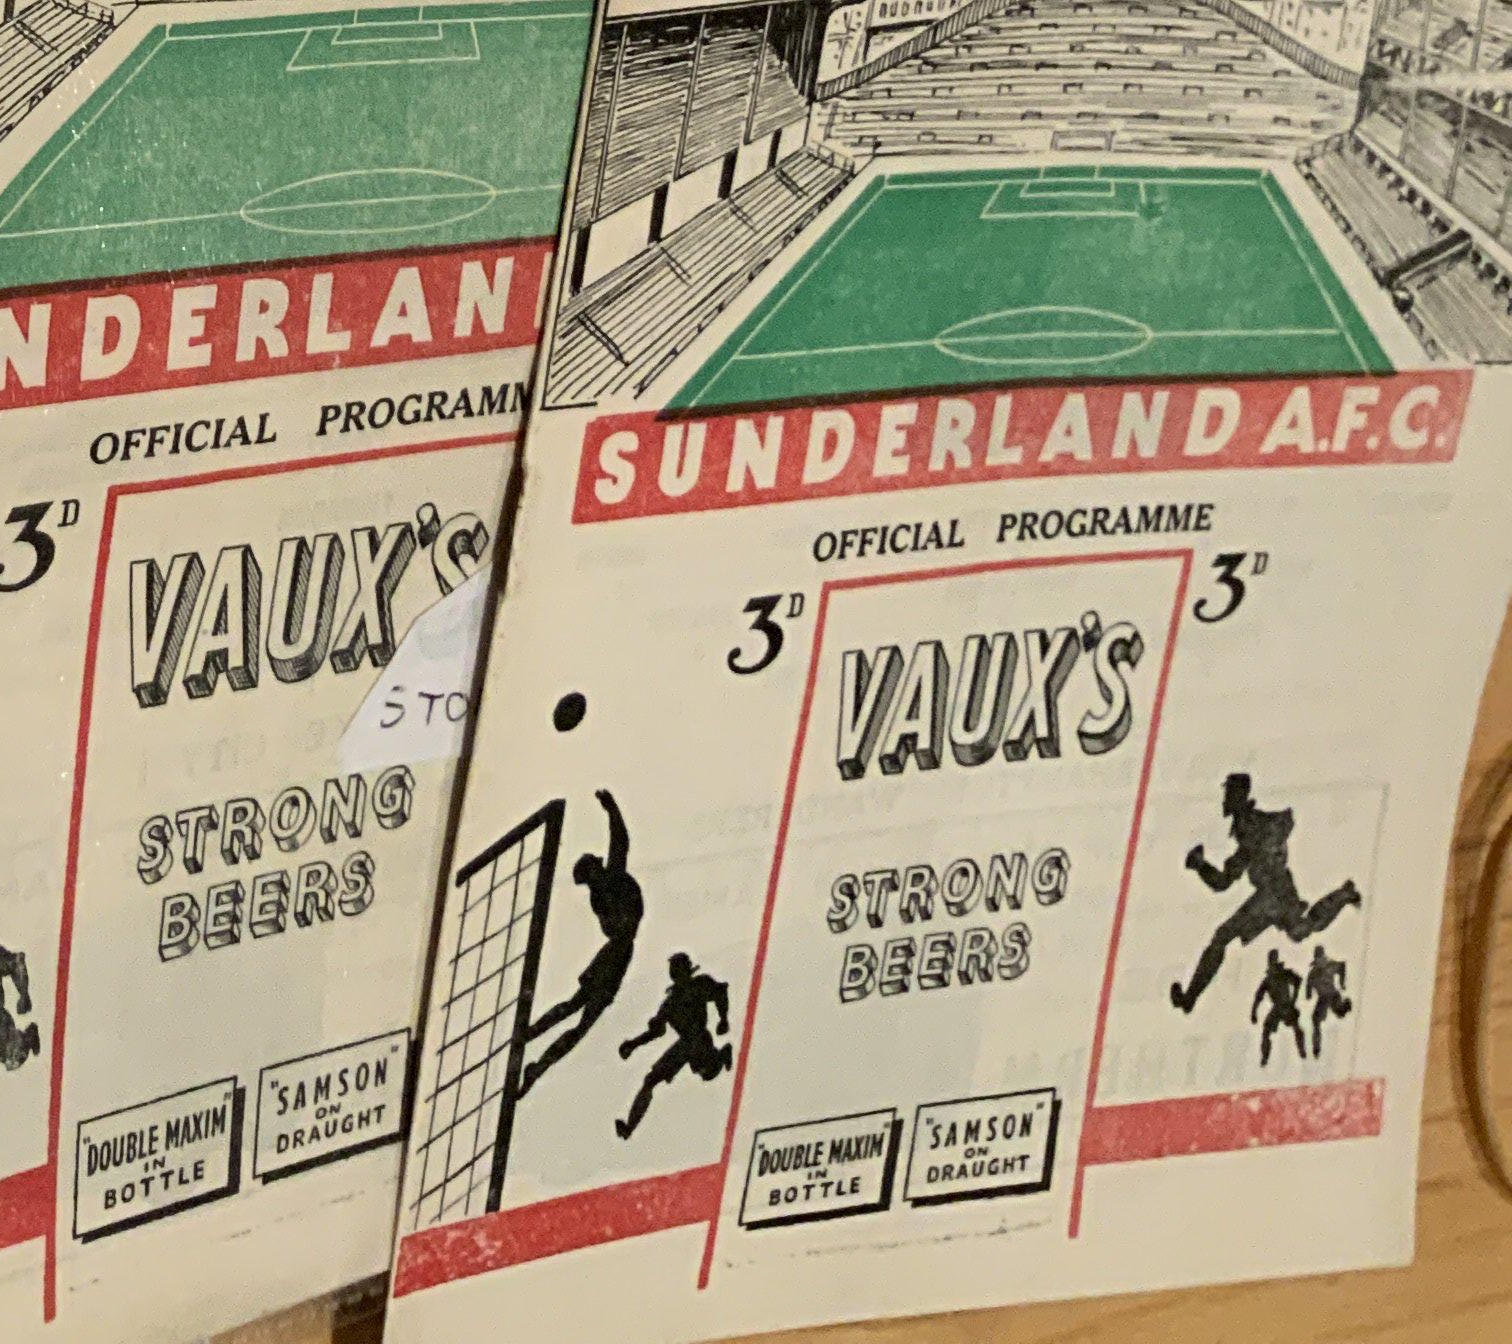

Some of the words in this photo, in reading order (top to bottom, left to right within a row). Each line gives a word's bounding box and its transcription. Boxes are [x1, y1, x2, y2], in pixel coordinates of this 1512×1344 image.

[89, 412, 278, 467] OFFICIAL
[594, 389, 1240, 507] SUNDERLAND
[1260, 378, 1450, 456] A.F.C.
[812, 518, 966, 564] OFFICIAL
[997, 503, 1215, 545] PROGRAMME
[836, 608, 1145, 781] VAUX'S
[137, 764, 416, 886] STRONG
[158, 850, 376, 963] BEERS
[826, 847, 1072, 935] STRONG
[839, 921, 1033, 1004] BEERS
[276, 1104, 387, 1154] DRAUGHT
[315, 1101, 342, 1121] ON
[144, 1156, 167, 1173] IN
[808, 1168, 828, 1181] IN
[927, 1153, 1031, 1184] DRAUGHT
[964, 1146, 989, 1160] ON
[104, 1160, 206, 1210] BOTTLE
[769, 1176, 862, 1207] BOTTLE
